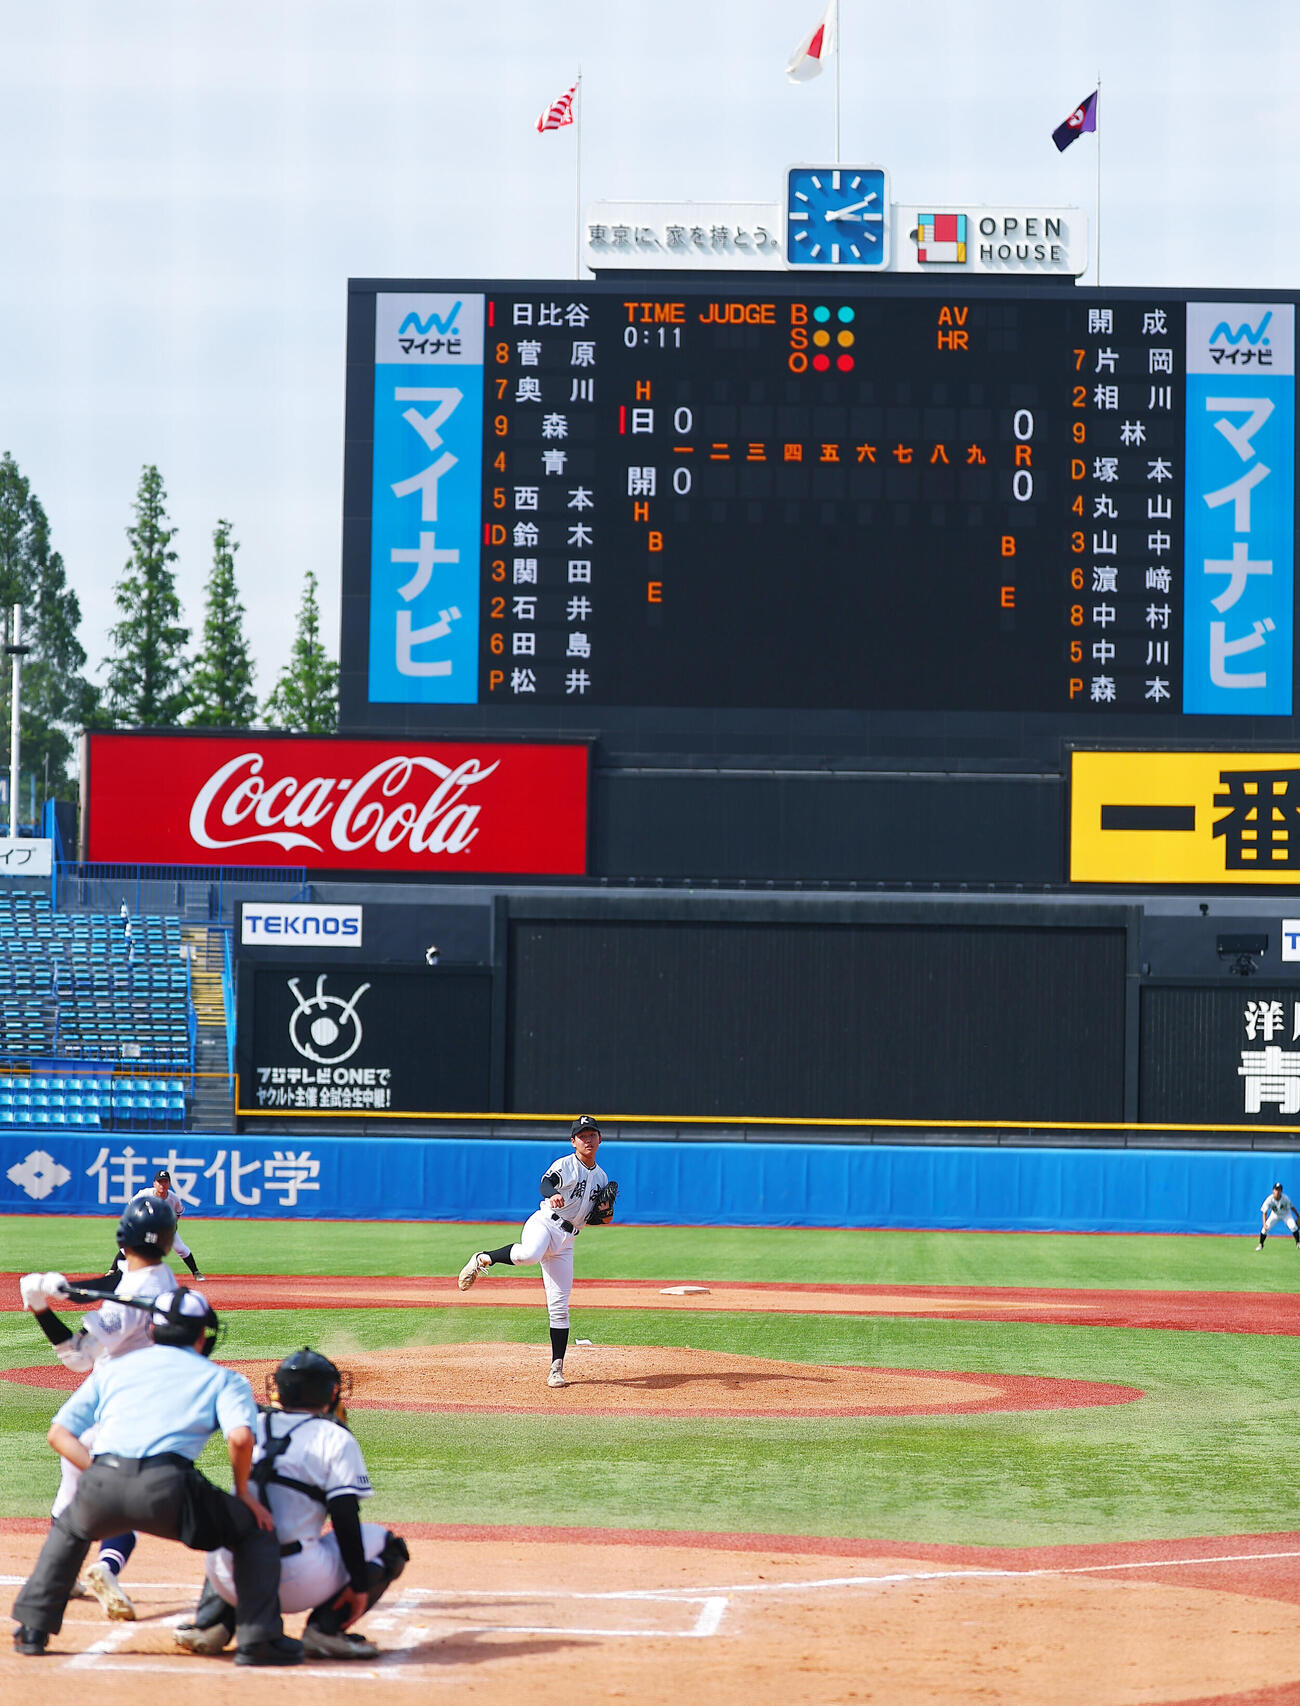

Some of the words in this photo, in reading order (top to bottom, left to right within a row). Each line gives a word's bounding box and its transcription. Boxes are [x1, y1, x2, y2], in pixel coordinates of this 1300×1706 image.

[588, 224, 778, 249] 東京に、家を持とう。
[979, 217, 1061, 237] OPEN
[980, 244, 1060, 262] HOUSE
[513, 302, 590, 327] 日比谷
[624, 302, 686, 323] TIME
[699, 303, 777, 324] JUDGE
[790, 303, 809, 325] B
[938, 306, 970, 326] AV
[398, 338, 462, 355] マイナビ
[624, 326, 681, 348] 0:11
[789, 327, 809, 350] S
[937, 330, 970, 351] HR
[496, 343, 508, 363] 8
[788, 351, 809, 373] O
[1074, 350, 1085, 370] 7
[1208, 348, 1273, 366] マイナビ
[496, 379, 507, 399] 7
[635, 380, 651, 401] H
[1073, 386, 1086, 407] 2
[495, 415, 507, 435] 9
[541, 412, 568, 439] 森
[632, 408, 654, 434] 日
[674, 406, 693, 434] 0
[1013, 409, 1034, 441] 0
[1073, 423, 1085, 443] 9
[1120, 420, 1146, 447] 林
[494, 452, 506, 472] 4
[541, 448, 567, 476] 青
[1015, 445, 1032, 466] R
[1071, 459, 1085, 480] D
[627, 466, 656, 497] 開
[673, 467, 692, 495] 0
[1012, 470, 1033, 501] 0
[494, 488, 505, 508] 5
[1072, 496, 1083, 516] 4
[634, 501, 649, 522] H
[391, 387, 464, 677] マイナビ
[491, 524, 506, 545] D
[648, 532, 663, 552] B
[1072, 532, 1084, 552] 3
[1001, 536, 1016, 557] B
[1203, 397, 1276, 689] マイナビ
[492, 561, 505, 581] 3
[1072, 568, 1084, 589] 6
[647, 582, 662, 602] E
[1001, 587, 1015, 608] E
[491, 597, 504, 618] 2
[1071, 605, 1083, 626] 8
[491, 634, 503, 654] 6
[1071, 641, 1082, 662] 5
[490, 671, 503, 691] P
[1070, 679, 1083, 699] P
[189, 753, 500, 854] Coca-Cola
[1101, 769, 1300, 870] 一番
[244, 915, 359, 936] TEKNOS
[1244, 1000, 1300, 1042] 洋
[85, 1146, 320, 1207] 住友化学
